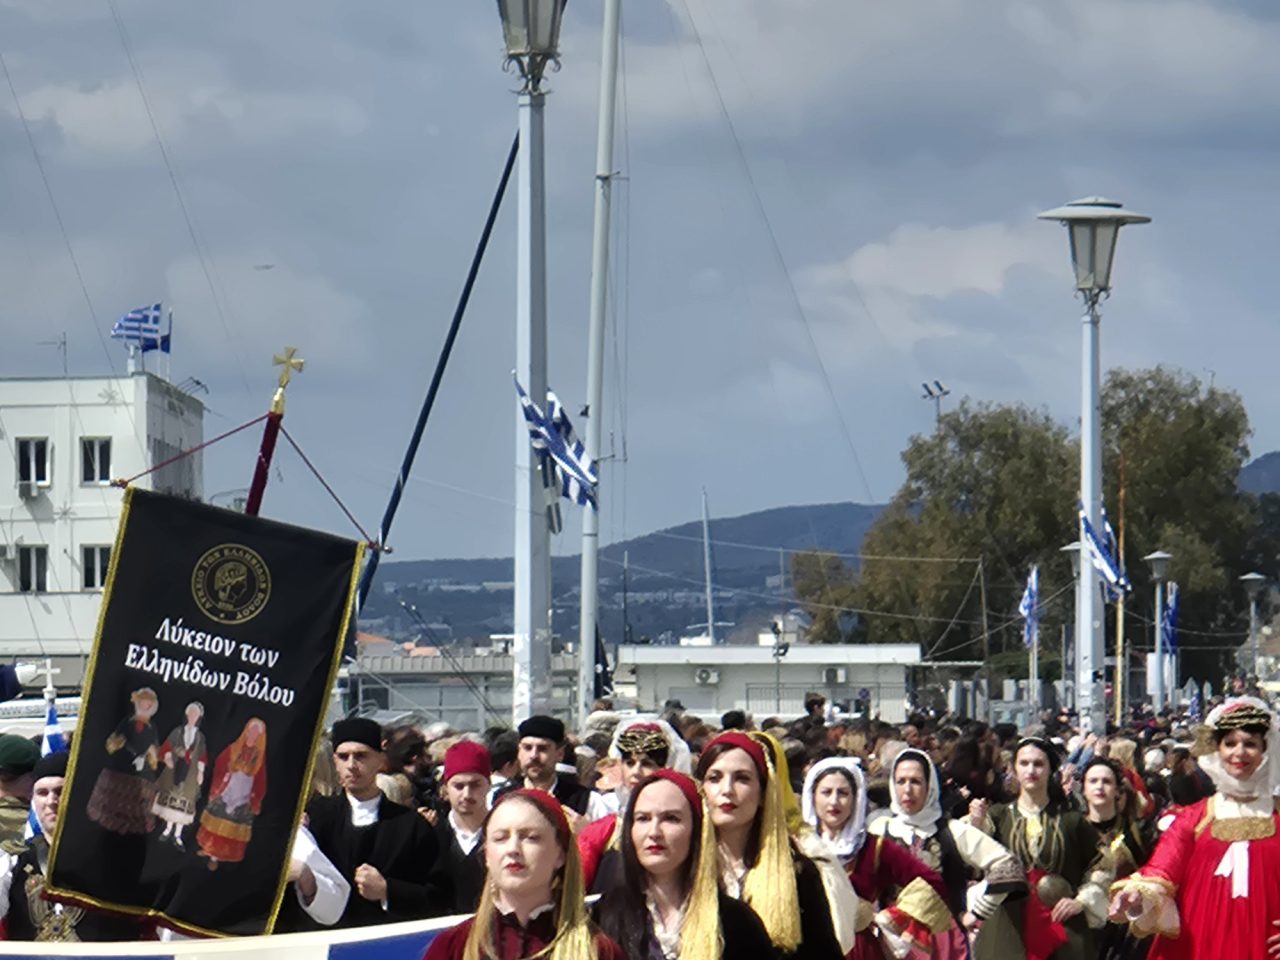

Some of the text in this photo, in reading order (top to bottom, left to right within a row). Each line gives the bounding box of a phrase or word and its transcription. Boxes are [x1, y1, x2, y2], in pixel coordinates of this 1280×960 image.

[155, 617, 280, 668] Λύκειον των
[124, 643, 295, 707] Ελληνίδων Βόλου
